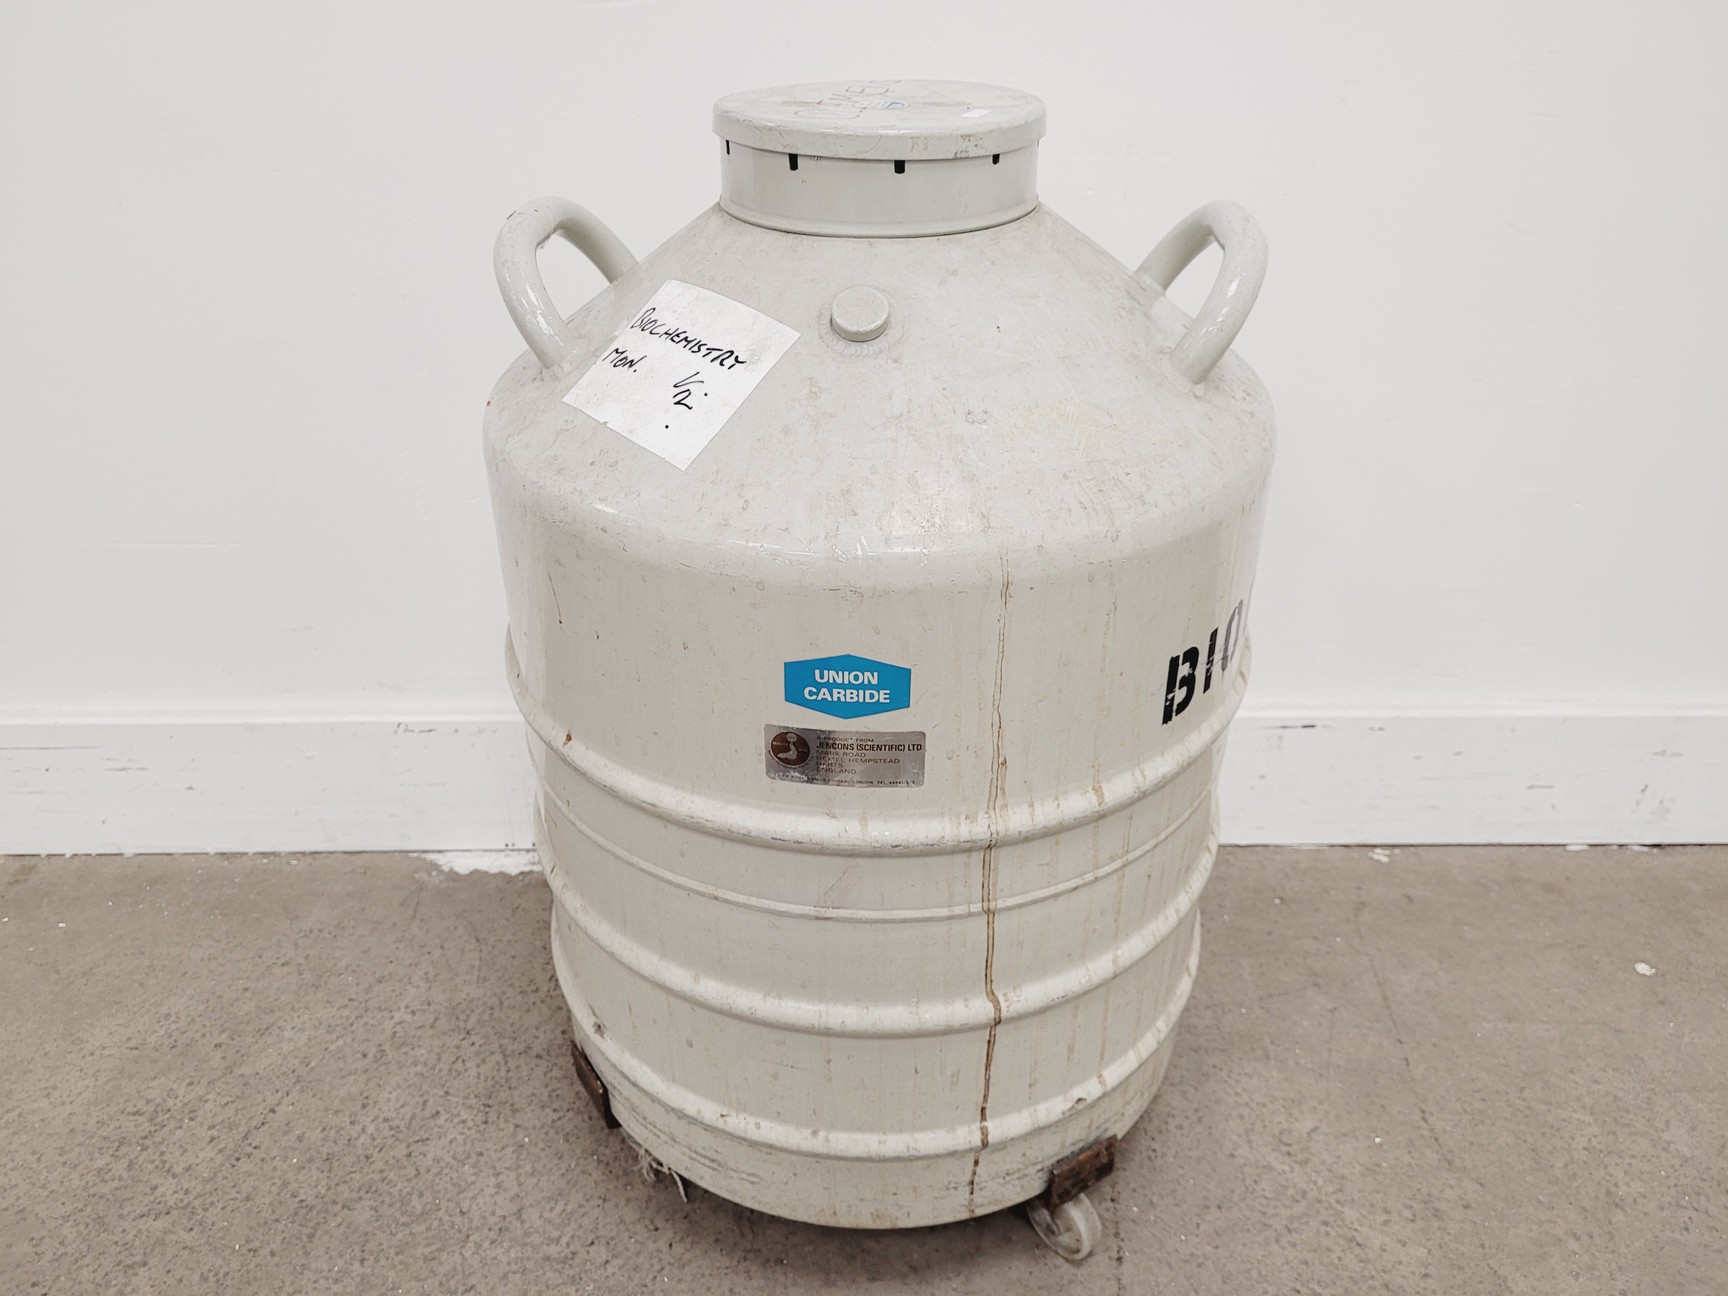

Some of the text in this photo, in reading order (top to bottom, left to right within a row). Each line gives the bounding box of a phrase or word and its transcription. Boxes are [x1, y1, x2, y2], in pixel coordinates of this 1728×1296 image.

[630, 307, 747, 370] BIOCHEMISTRY
[814, 669, 878, 685] UNION
[803, 686, 890, 703] CARBIDE
[816, 741, 855, 751] JENCONS
[856, 743, 906, 752] (SCIENTIFIC)
[816, 755, 845, 763] HEMEL
[816, 766, 857, 775] ENGLAND
